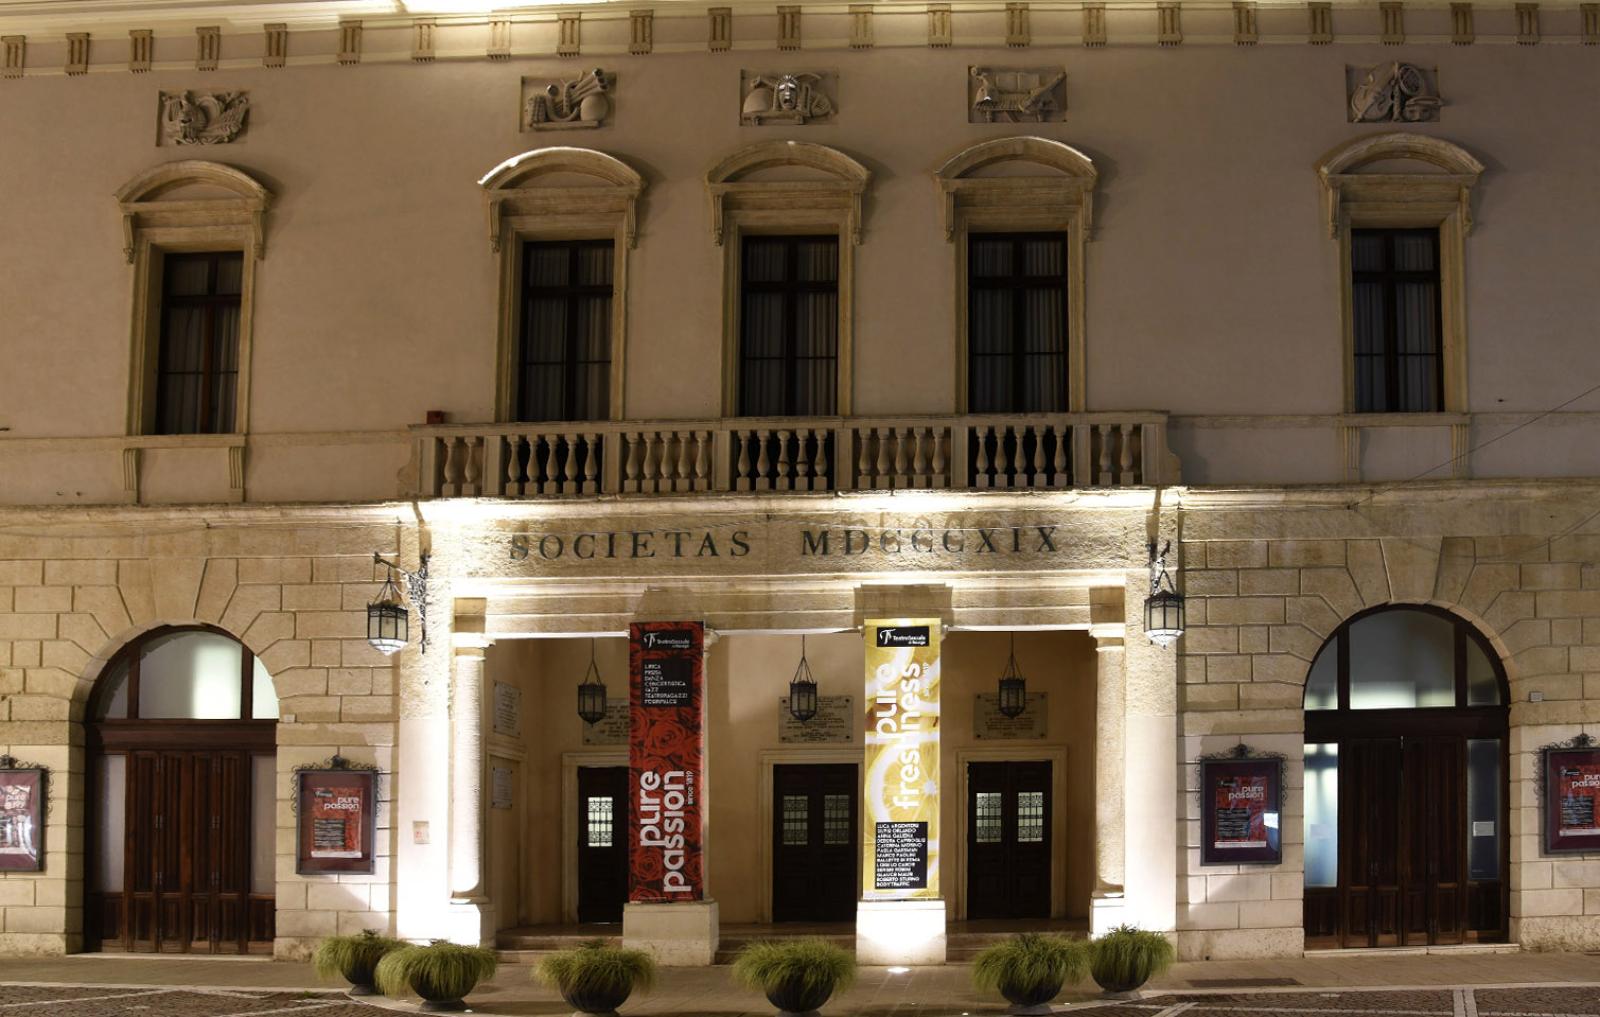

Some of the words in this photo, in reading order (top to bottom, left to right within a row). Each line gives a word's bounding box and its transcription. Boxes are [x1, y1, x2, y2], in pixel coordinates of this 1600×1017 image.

[508, 529, 752, 562] SOCIETAS
[801, 526, 1059, 556] MDCCCXIX
[875, 662, 904, 738] pure
[892, 662, 920, 809] fresness
[339, 797, 359, 805] pure
[640, 771, 668, 846] pure
[663, 770, 692, 892] passion
[1229, 792, 1264, 801] passion
